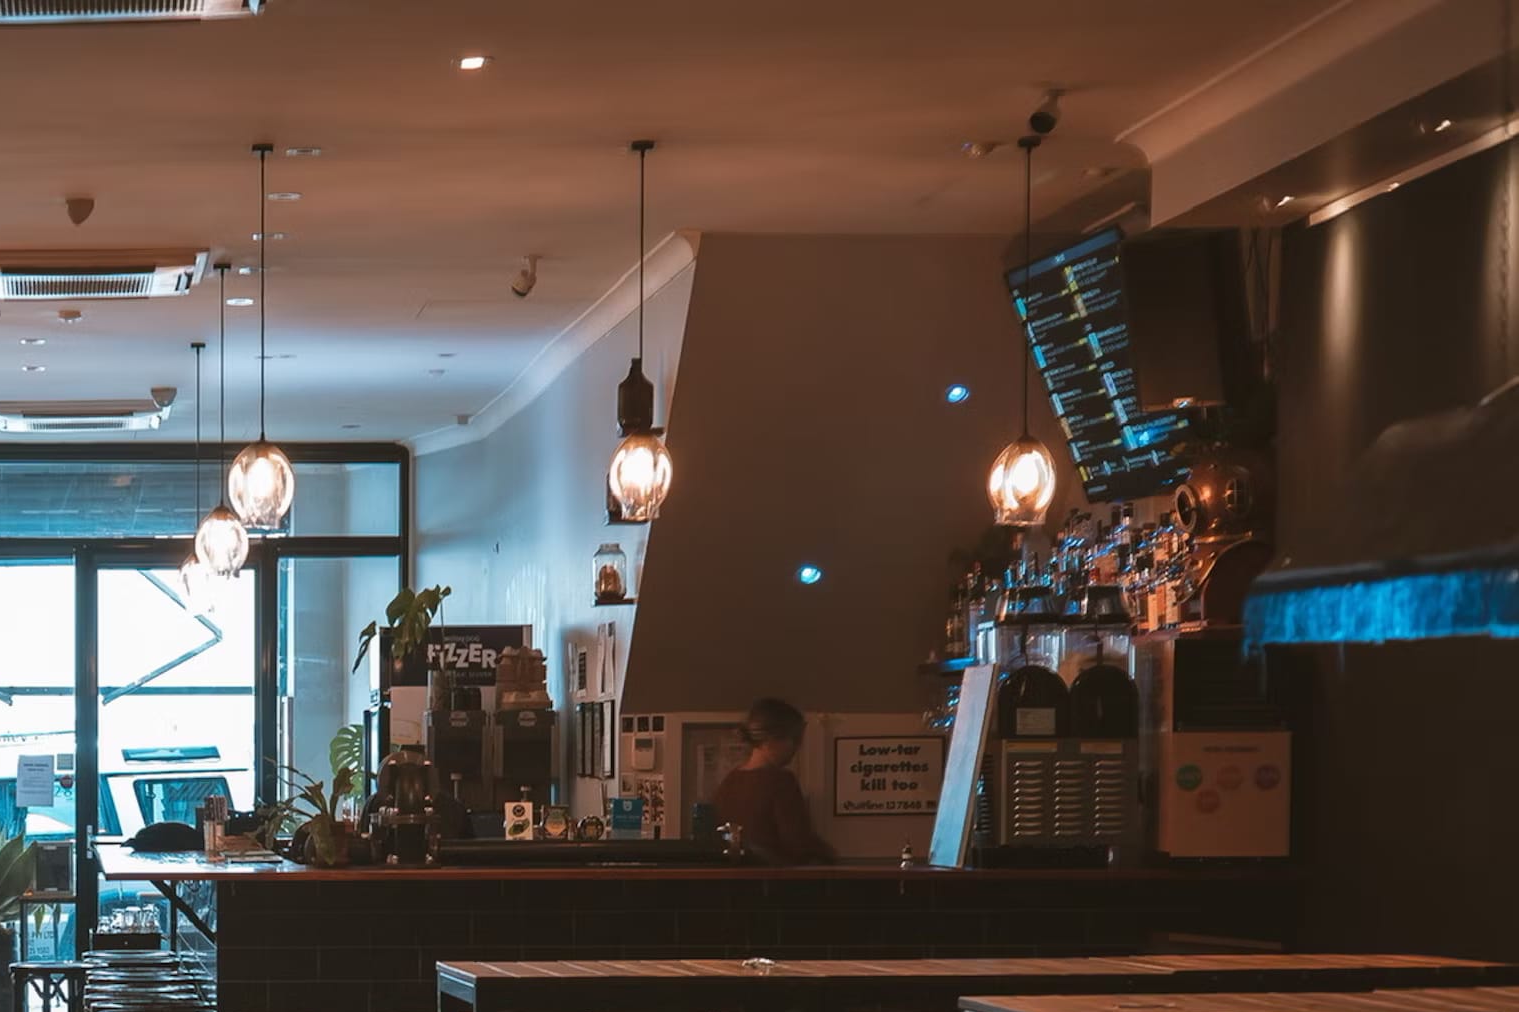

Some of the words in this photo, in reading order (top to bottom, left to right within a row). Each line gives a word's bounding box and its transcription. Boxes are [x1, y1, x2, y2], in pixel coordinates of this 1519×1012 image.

[427, 643, 497, 670] FIZZER
[858, 744, 921, 756] Low-tar
[850, 761, 930, 777] cigarettes
[860, 779, 886, 791] kill
[892, 780, 919, 791] too
